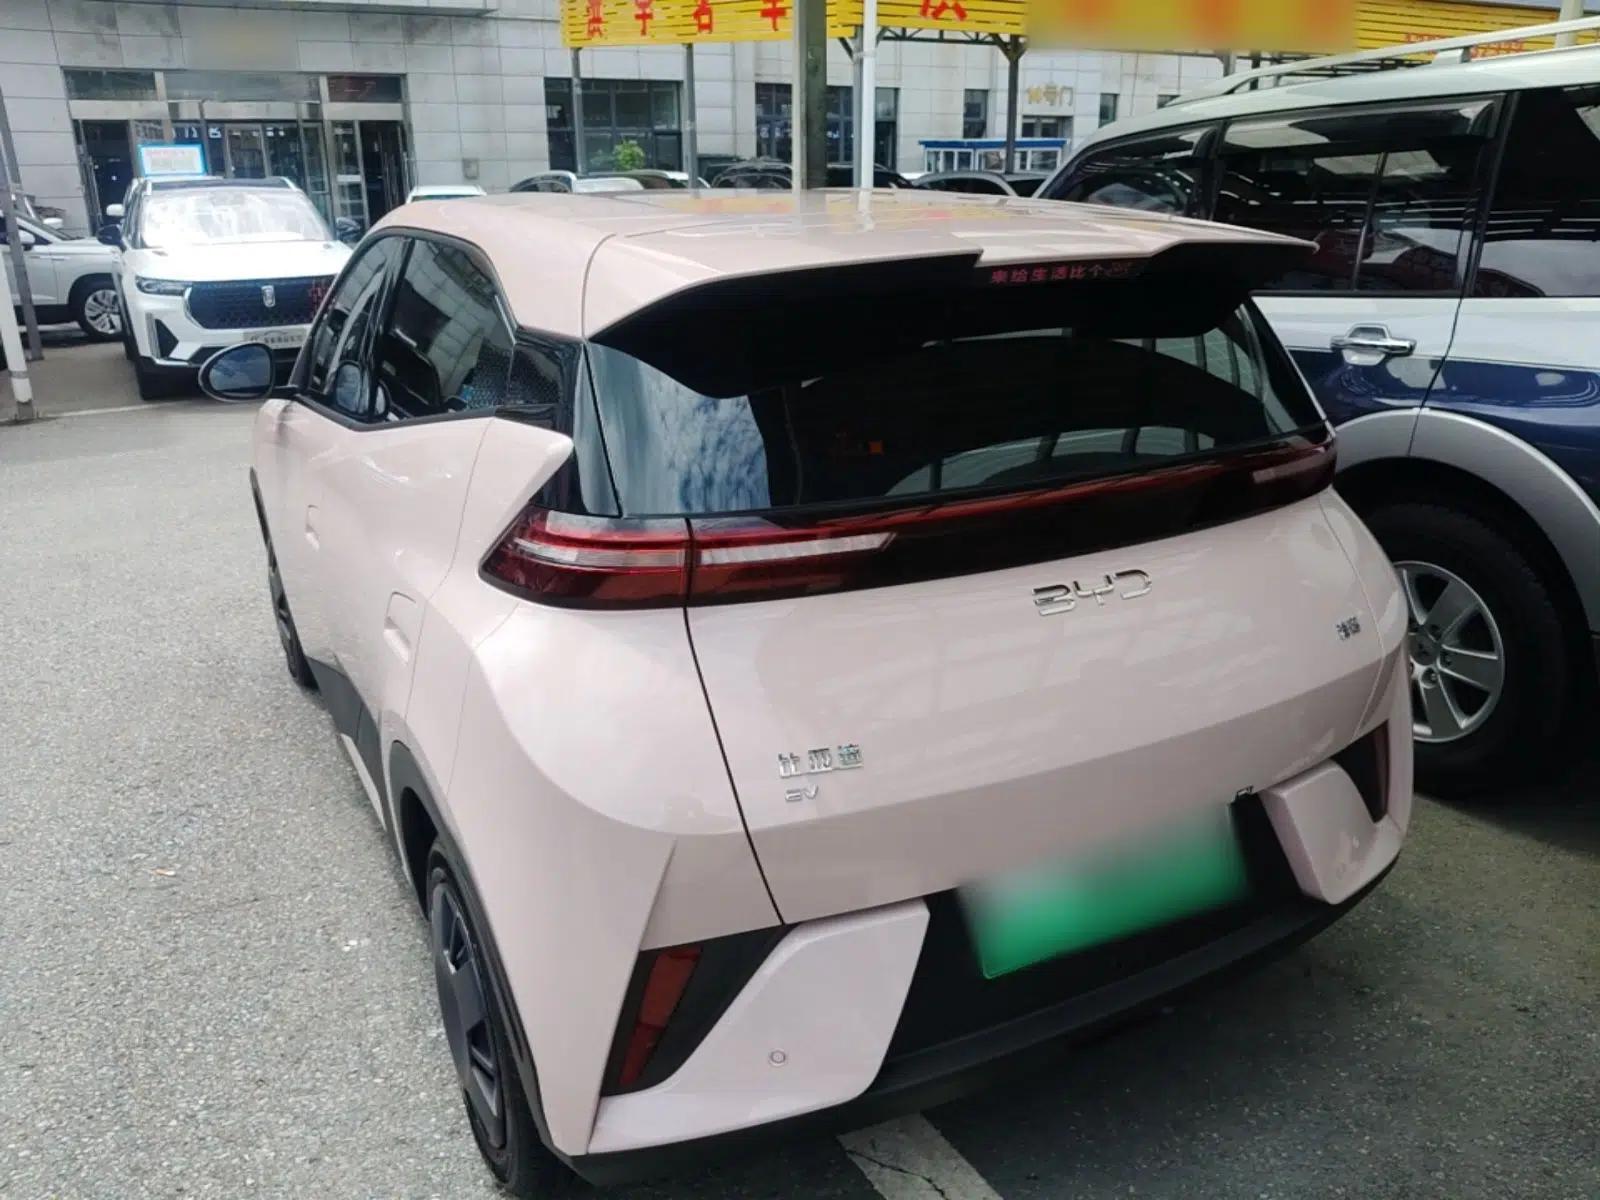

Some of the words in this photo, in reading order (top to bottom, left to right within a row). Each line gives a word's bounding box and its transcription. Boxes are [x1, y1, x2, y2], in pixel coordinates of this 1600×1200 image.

[1032, 569, 1152, 616] BYD
[778, 743, 863, 779] 比亚迪
[785, 784, 820, 803] EV
